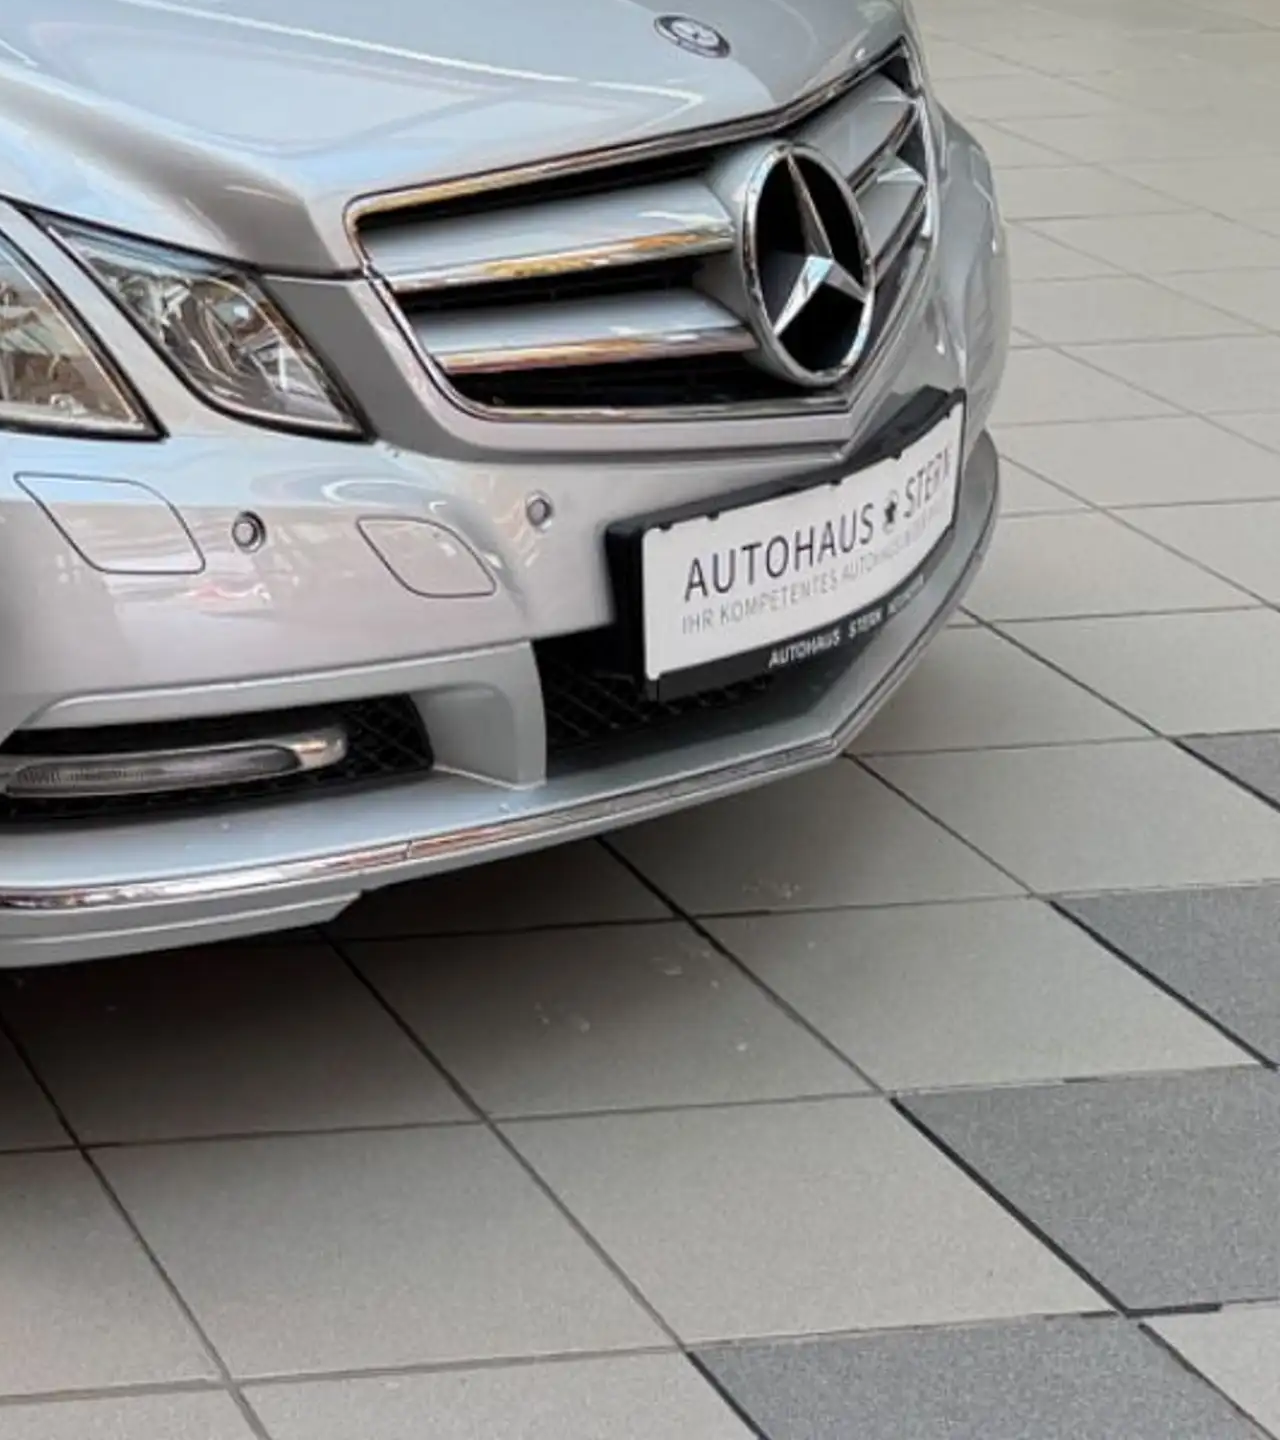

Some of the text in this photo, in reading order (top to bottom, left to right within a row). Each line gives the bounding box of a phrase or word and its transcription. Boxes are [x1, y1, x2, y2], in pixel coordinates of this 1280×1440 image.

[684, 501, 875, 603] AUTOHAUS
[682, 607, 714, 635] IHR
[720, 568, 838, 626] KOMPETENTES
[768, 625, 840, 669] AUTOHAUS
